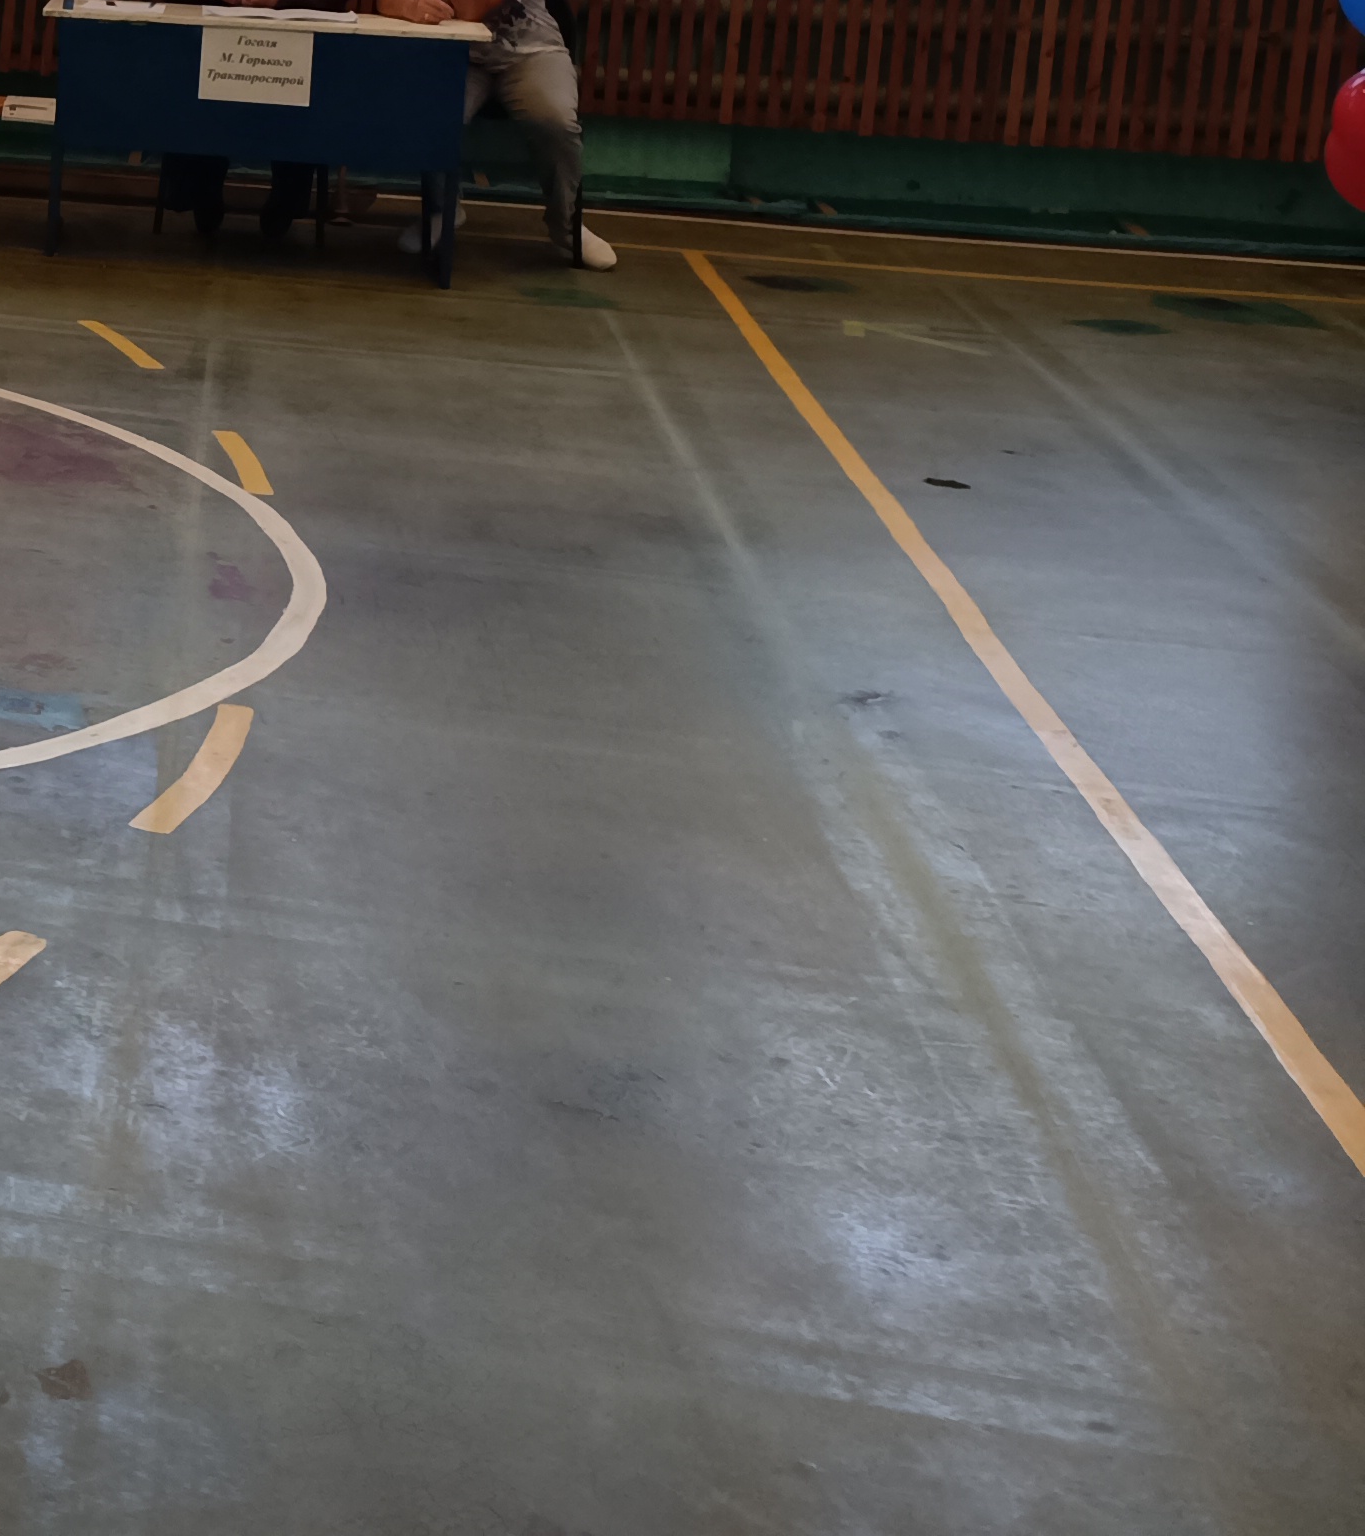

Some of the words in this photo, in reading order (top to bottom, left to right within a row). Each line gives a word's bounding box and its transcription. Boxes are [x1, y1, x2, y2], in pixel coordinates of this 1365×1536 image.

[237, 35, 278, 48] Гоголя
[220, 52, 235, 64] М.
[239, 53, 293, 67] Горького
[207, 68, 304, 87] Тракторострой
